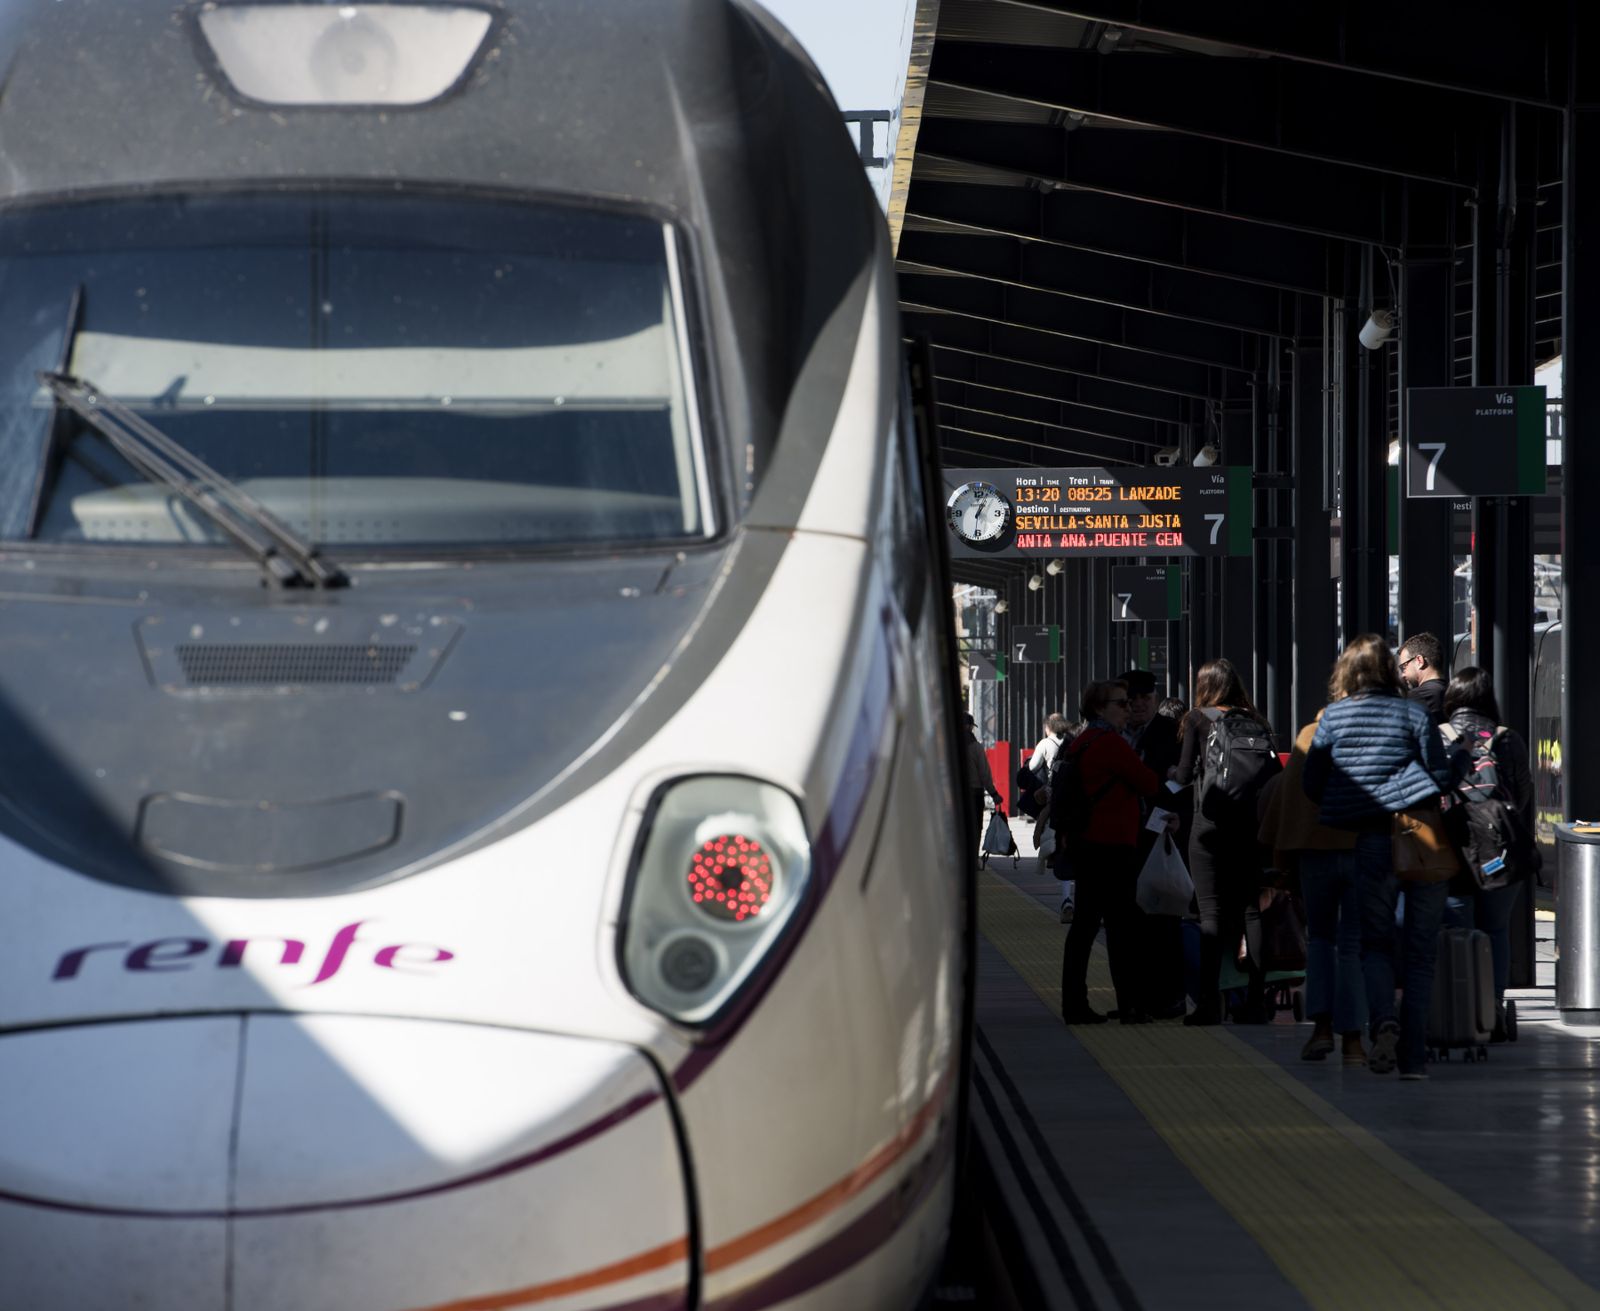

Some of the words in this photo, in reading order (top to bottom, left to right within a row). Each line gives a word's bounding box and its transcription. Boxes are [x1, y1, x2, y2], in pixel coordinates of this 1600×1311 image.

[1496, 392, 1514, 404] Vía
[1475, 408, 1514, 416] PLATFORM
[1418, 442, 1447, 491] 7
[1016, 477, 1037, 486] Hora
[1069, 476, 1089, 485] Tren
[1211, 474, 1225, 484] Vía
[974, 490, 984, 498] 12
[1015, 487, 1060, 502] 13:20
[1067, 487, 1112, 501] 08525
[1119, 486, 1182, 501] LANZADE
[1016, 504, 1050, 514] Destino
[1015, 515, 1129, 530] SEVILLA-SANTA
[1137, 514, 1181, 529] JUSTA
[1203, 513, 1225, 545] 7
[975, 529, 982, 537] 6
[1017, 533, 1052, 548] ANTA
[1155, 532, 1183, 547] GEN
[1117, 592, 1133, 619] 7
[1015, 643, 1027, 661] 7
[970, 665, 980, 681] 7
[50, 917, 455, 989] renfe
